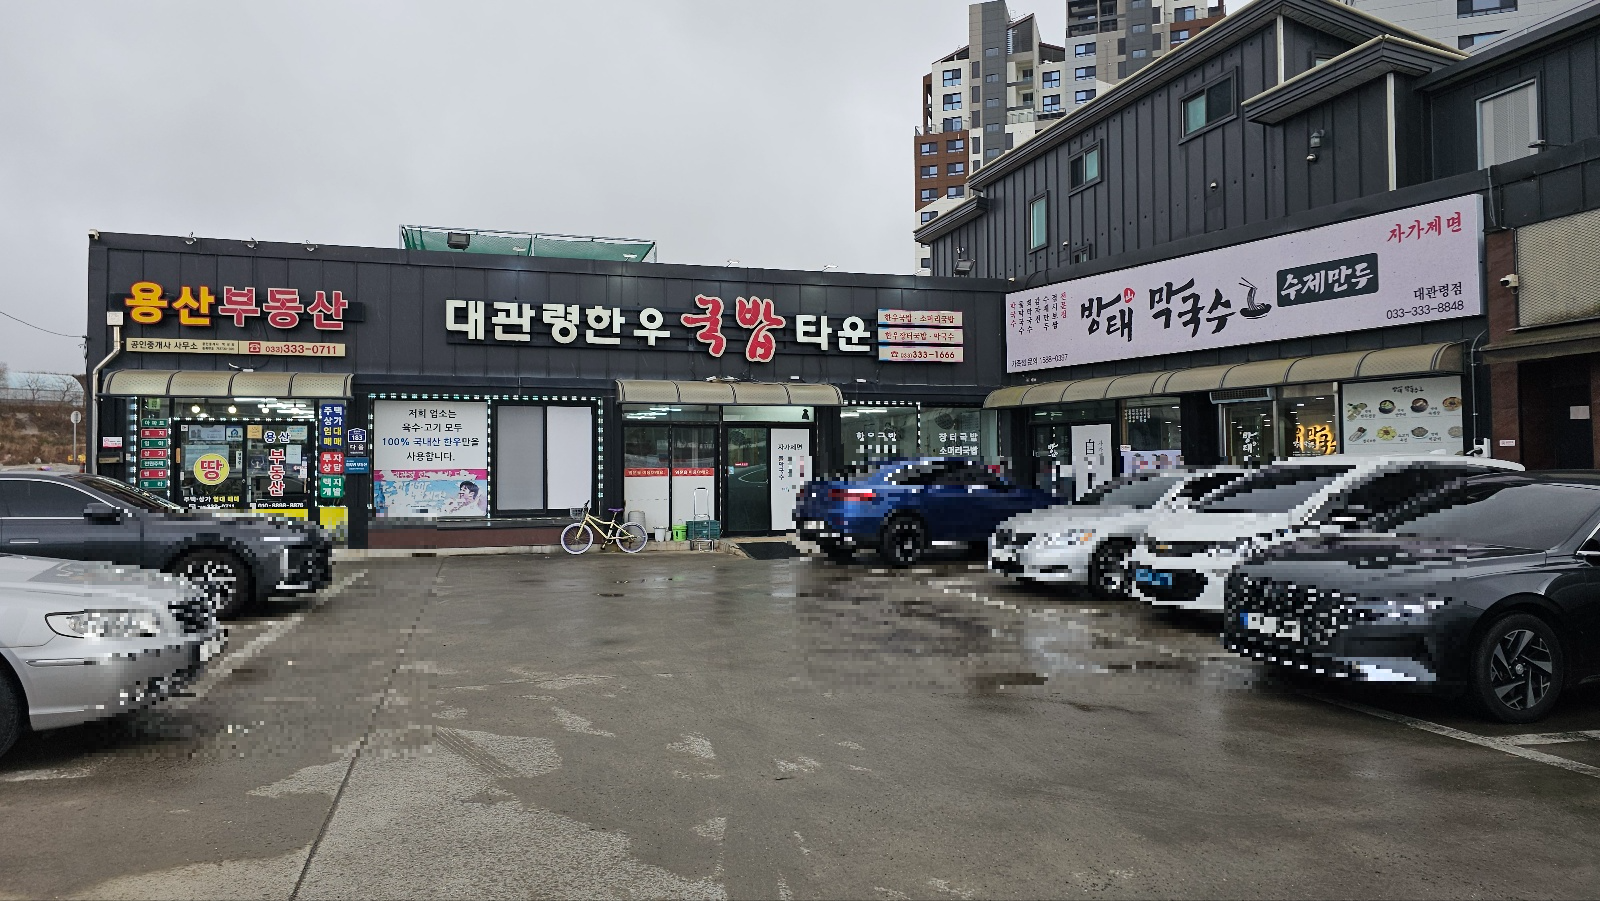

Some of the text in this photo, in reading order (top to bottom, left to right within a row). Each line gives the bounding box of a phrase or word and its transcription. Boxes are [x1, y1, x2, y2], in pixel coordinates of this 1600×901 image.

[1387, 211, 1462, 243] 자가제면
[1279, 262, 1374, 301] 수제만두
[1414, 281, 1462, 301] 대관령점
[1080, 277, 1236, 343] 방태 막국수
[1387, 302, 1464, 319] 033-333-8848
[130, 341, 171, 351] 공인중개사
[174, 342, 199, 352] 사무소
[323, 406, 343, 416] 주택
[408, 408, 457, 419] 저희 업소는
[323, 417, 343, 426] 상가
[323, 426, 342, 436] 임대
[444, 423, 463, 433] 모두
[264, 430, 291, 444] 용산
[323, 437, 342, 447] 매매
[382, 437, 480, 448] 100% 국내산 한우만을
[939, 445, 979, 456] 소머리국밥
[323, 453, 342, 463] 투자
[406, 451, 456, 463] 사용합니다.
[199, 459, 225, 482] 땅
[268, 448, 285, 497] 부동산
[323, 463, 342, 473] 상담
[322, 477, 342, 487] 택지
[322, 487, 342, 497] 개발
